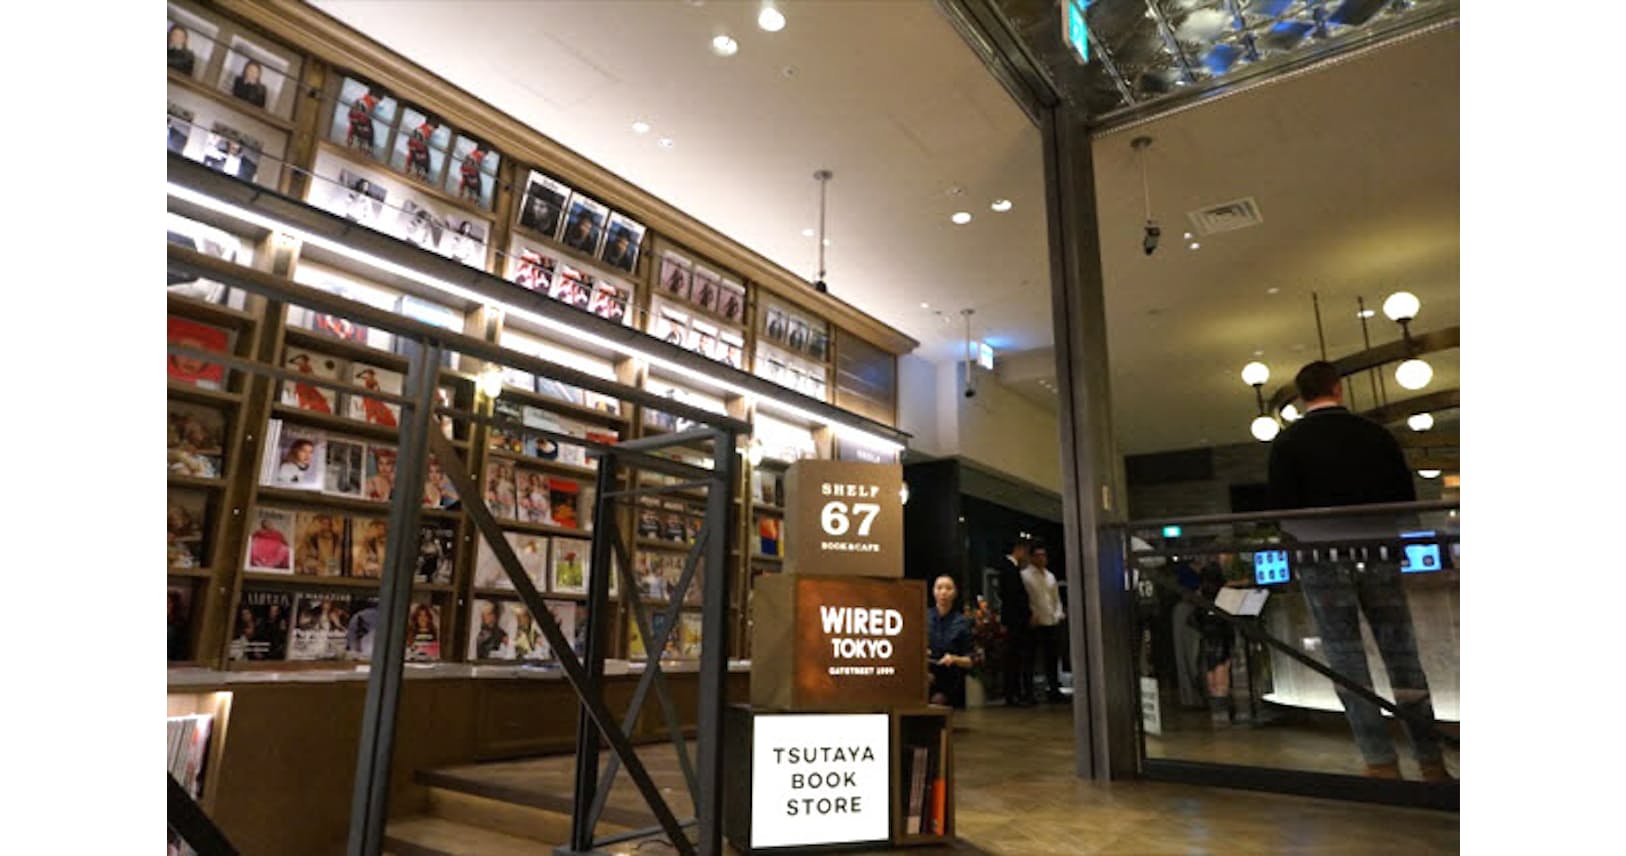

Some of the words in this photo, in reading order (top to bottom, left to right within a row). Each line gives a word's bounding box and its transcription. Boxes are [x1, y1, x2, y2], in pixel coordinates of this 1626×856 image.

[821, 482, 880, 498] SHELF
[821, 500, 880, 536] 67
[820, 605, 904, 636] WIRED
[831, 638, 893, 659] TOKYO
[773, 746, 875, 764] TSUTAYA
[791, 771, 856, 789] BOOK
[787, 796, 862, 816] STORE
